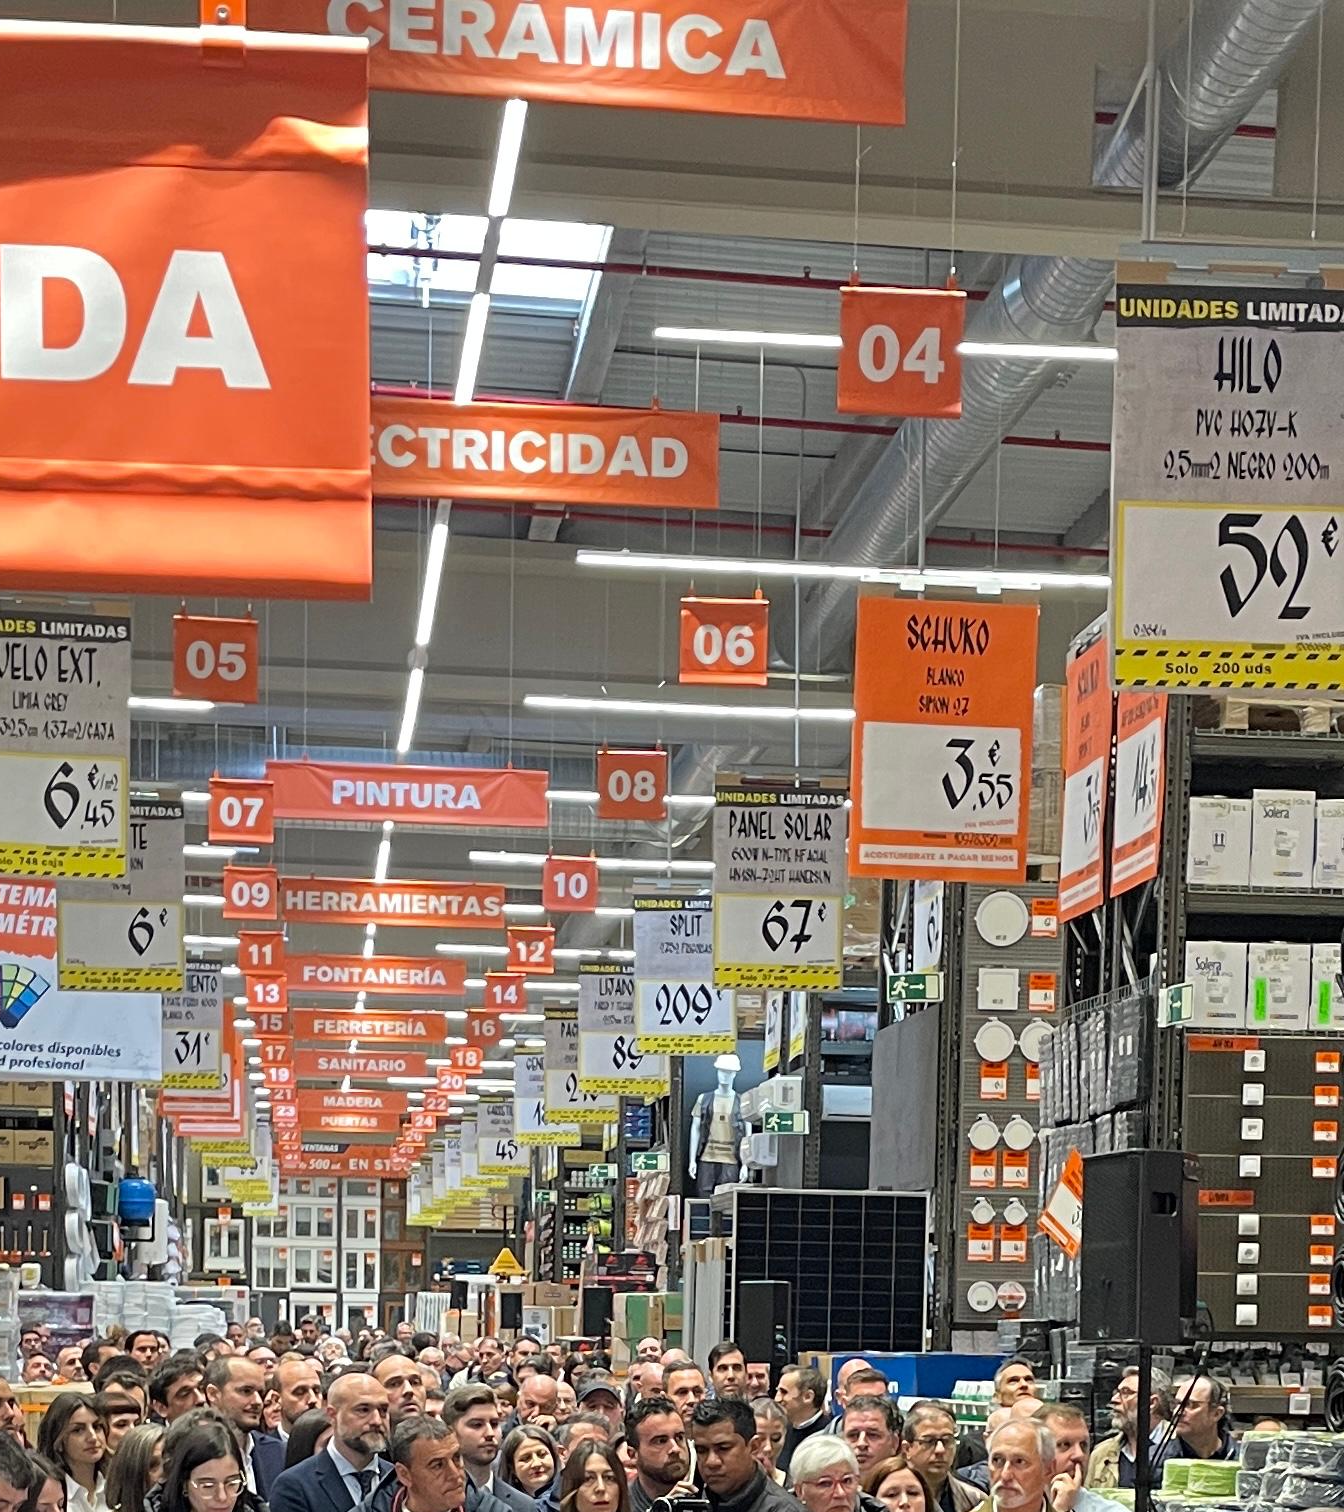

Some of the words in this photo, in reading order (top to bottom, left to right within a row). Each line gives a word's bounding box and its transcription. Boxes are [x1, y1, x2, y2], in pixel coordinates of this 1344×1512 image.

[1119, 298, 1239, 319] UNIDADES
[858, 325, 945, 383] 04
[1213, 336, 1282, 393] HILO
[1196, 408, 1223, 436] PVC
[371, 425, 689, 479] CTRICIDAD
[1227, 451, 1276, 479] NEGRO
[1283, 452, 1330, 481] 200m
[1219, 513, 1311, 620] 52
[41, 621, 127, 639] LIMITADAS
[907, 614, 989, 656] SCHUKO
[693, 623, 755, 666] 06
[57, 645, 101, 688] EXT.
[186, 640, 247, 682] 05
[1165, 662, 1198, 674] Solo
[1212, 663, 1240, 674] 200
[1245, 663, 1272, 675] uds
[926, 667, 965, 687] BLANCO
[44, 692, 68, 711] GREY
[919, 695, 950, 715] SIMON
[953, 697, 969, 717] 27
[332, 779, 481, 810] PINTURA
[608, 769, 656, 802] 08
[716, 792, 777, 804] UNIDADES
[780, 794, 844, 806] LIMITADAS
[219, 797, 264, 827] 07
[1263, 806, 1290, 819] Solera
[729, 810, 776, 840] PANEL
[784, 812, 832, 841] SOLAR
[947, 853, 978, 862] PAGAR
[981, 854, 1014, 863] MENOS
[231, 881, 270, 907] 09
[553, 871, 588, 899] 10
[286, 890, 501, 917] HERRAMIENTAS
[635, 900, 683, 908] UNIDADES
[670, 914, 703, 936] SPLIT
[761, 900, 813, 954] 67
[248, 943, 272, 965] 11
[516, 941, 545, 963] 12
[580, 965, 621, 973] UNIDADES
[1195, 957, 1222, 971] Solera
[303, 964, 446, 986] FONTANERÍA
[255, 984, 280, 1003] 13
[493, 985, 518, 1004] 14
[656, 983, 713, 1026] 209
[260, 1014, 283, 1031] 15
[313, 1017, 427, 1036] FERRETERÍA
[471, 1020, 495, 1036] 16
[47, 1041, 121, 1059] disponibles
[265, 1046, 285, 1060] 17
[455, 1051, 477, 1066] 18
[8, 1056, 85, 1073] profesional
[269, 1067, 289, 1081] 19
[318, 1057, 406, 1072] SANITARIO
[440, 1076, 462, 1090] 20
[276, 1105, 295, 1117] 23
[323, 1096, 383, 1108] MADERA
[427, 1098, 447, 1111] 22
[321, 1116, 378, 1127] PUERTAS
[415, 1115, 433, 1127] 24
[348, 1159, 369, 1170] EN
